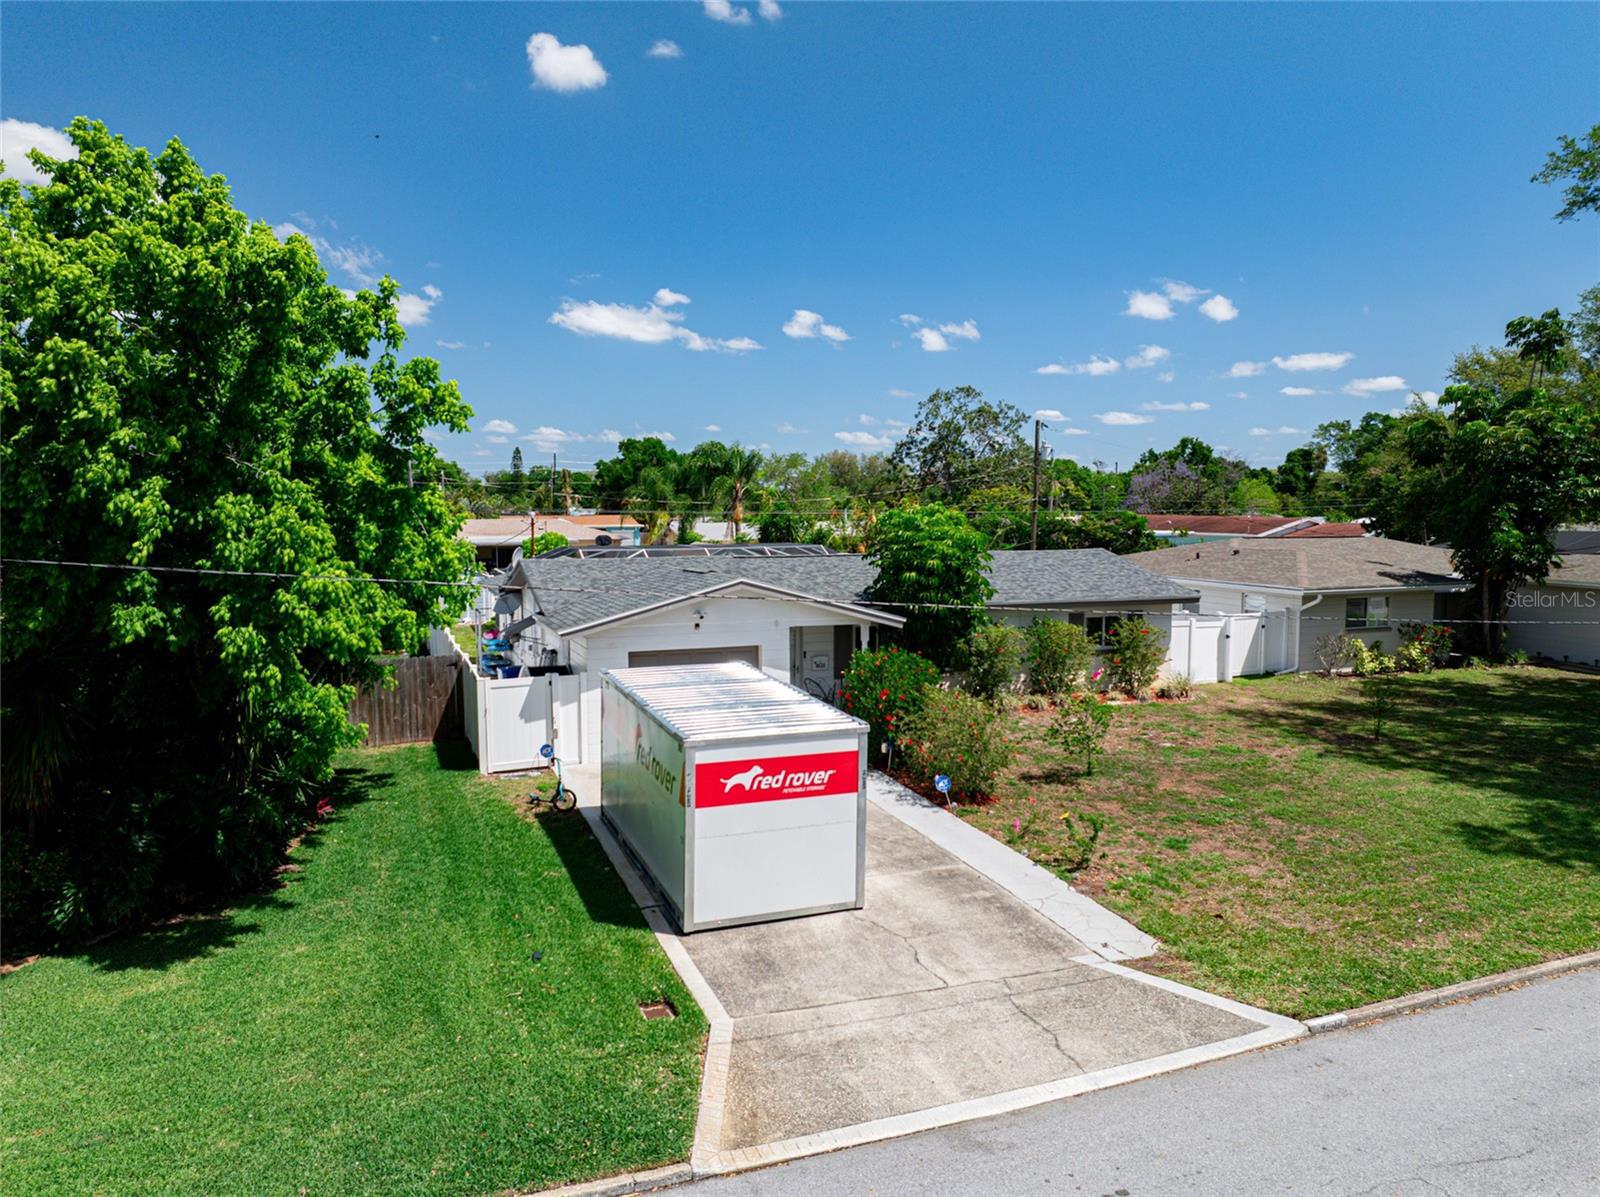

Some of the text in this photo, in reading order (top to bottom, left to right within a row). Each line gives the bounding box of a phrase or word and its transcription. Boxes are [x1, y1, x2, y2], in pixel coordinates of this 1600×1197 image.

[636, 743, 677, 795] red rover
[752, 769, 832, 790] red rover
